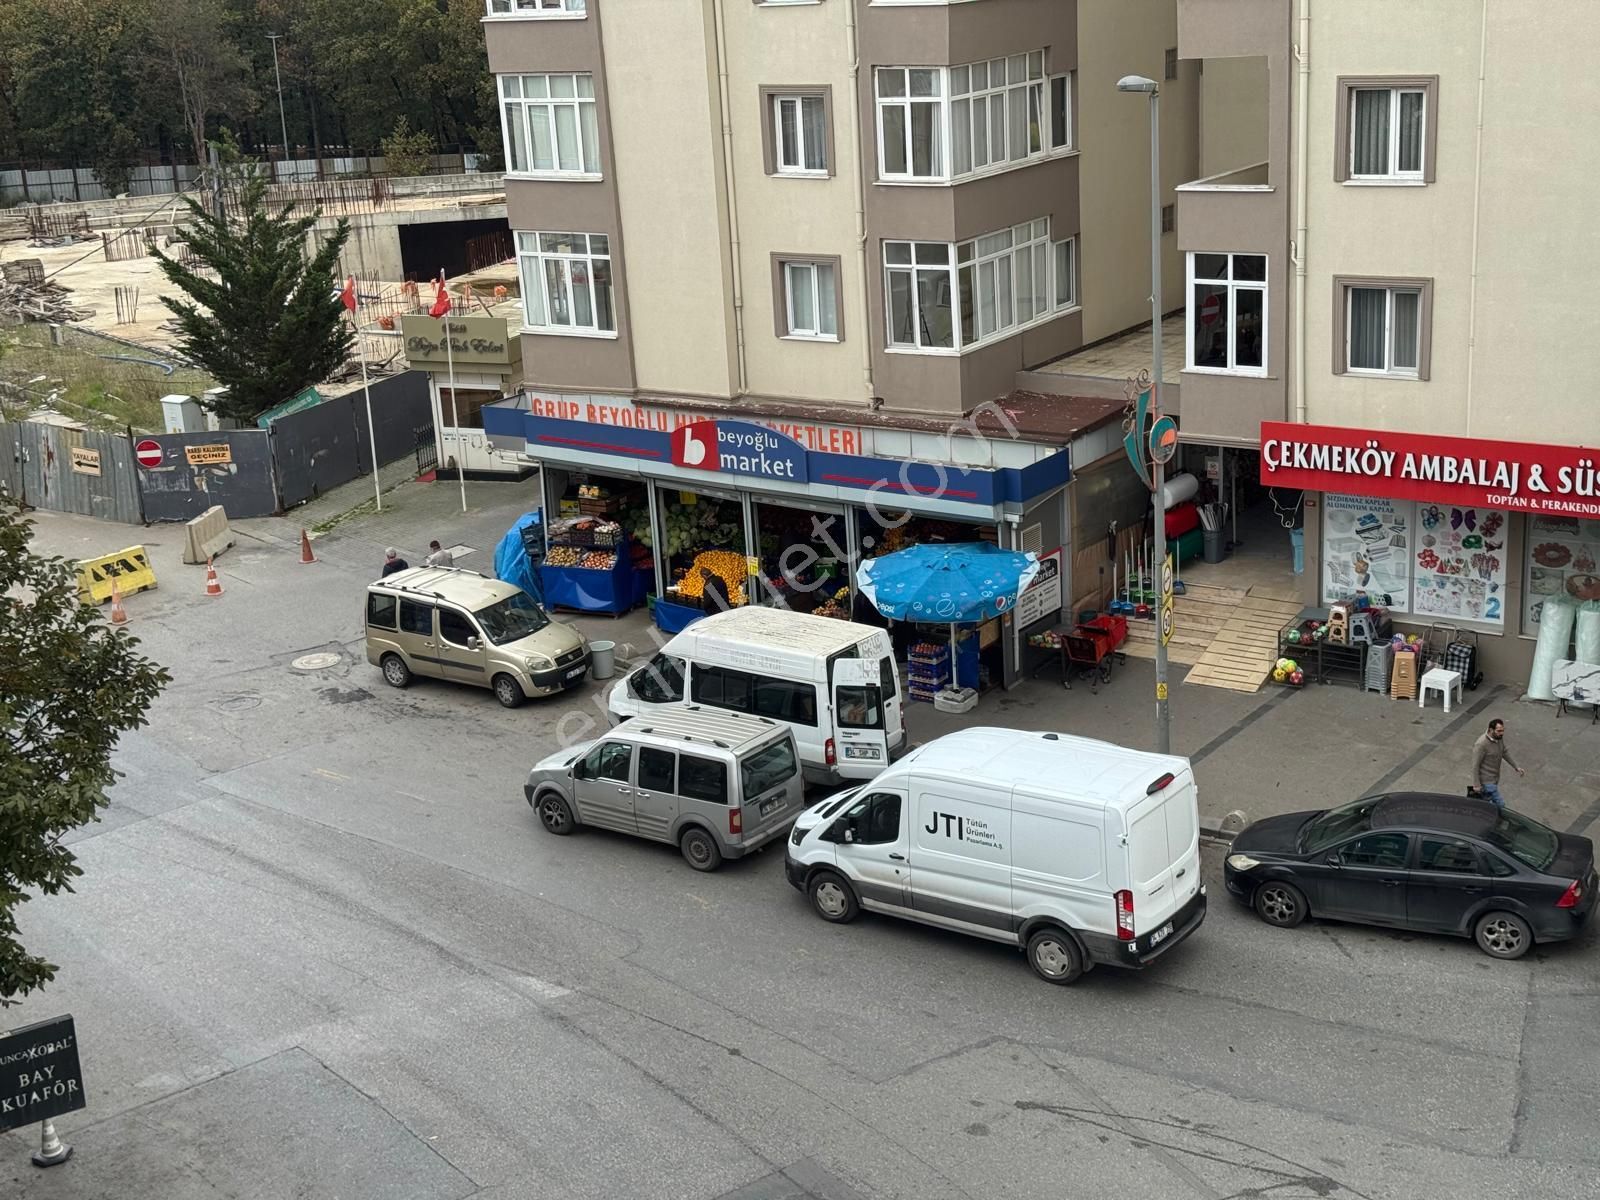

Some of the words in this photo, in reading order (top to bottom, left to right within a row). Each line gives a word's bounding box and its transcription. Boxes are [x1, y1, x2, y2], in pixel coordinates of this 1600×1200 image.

[533, 398, 579, 420] GRUP
[587, 404, 667, 432] BEYOĞLU
[717, 427, 778, 452] beyoğlu
[73, 453, 98, 463] YAYALAR
[720, 453, 794, 478] market
[1263, 440, 1396, 477] ÇEKMEKÖY
[1400, 453, 1520, 497] AMBALAJ
[1527, 464, 1551, 493] &
[1486, 494, 1528, 508] TOPTAN
[1530, 498, 1540, 509] &
[925, 811, 963, 840] JTI
[966, 817, 988, 830] Tütün
[966, 826, 996, 840] Ürünleri
[18, 1064, 56, 1089] BAY
[2, 1079, 79, 1113] KUAFÖR
